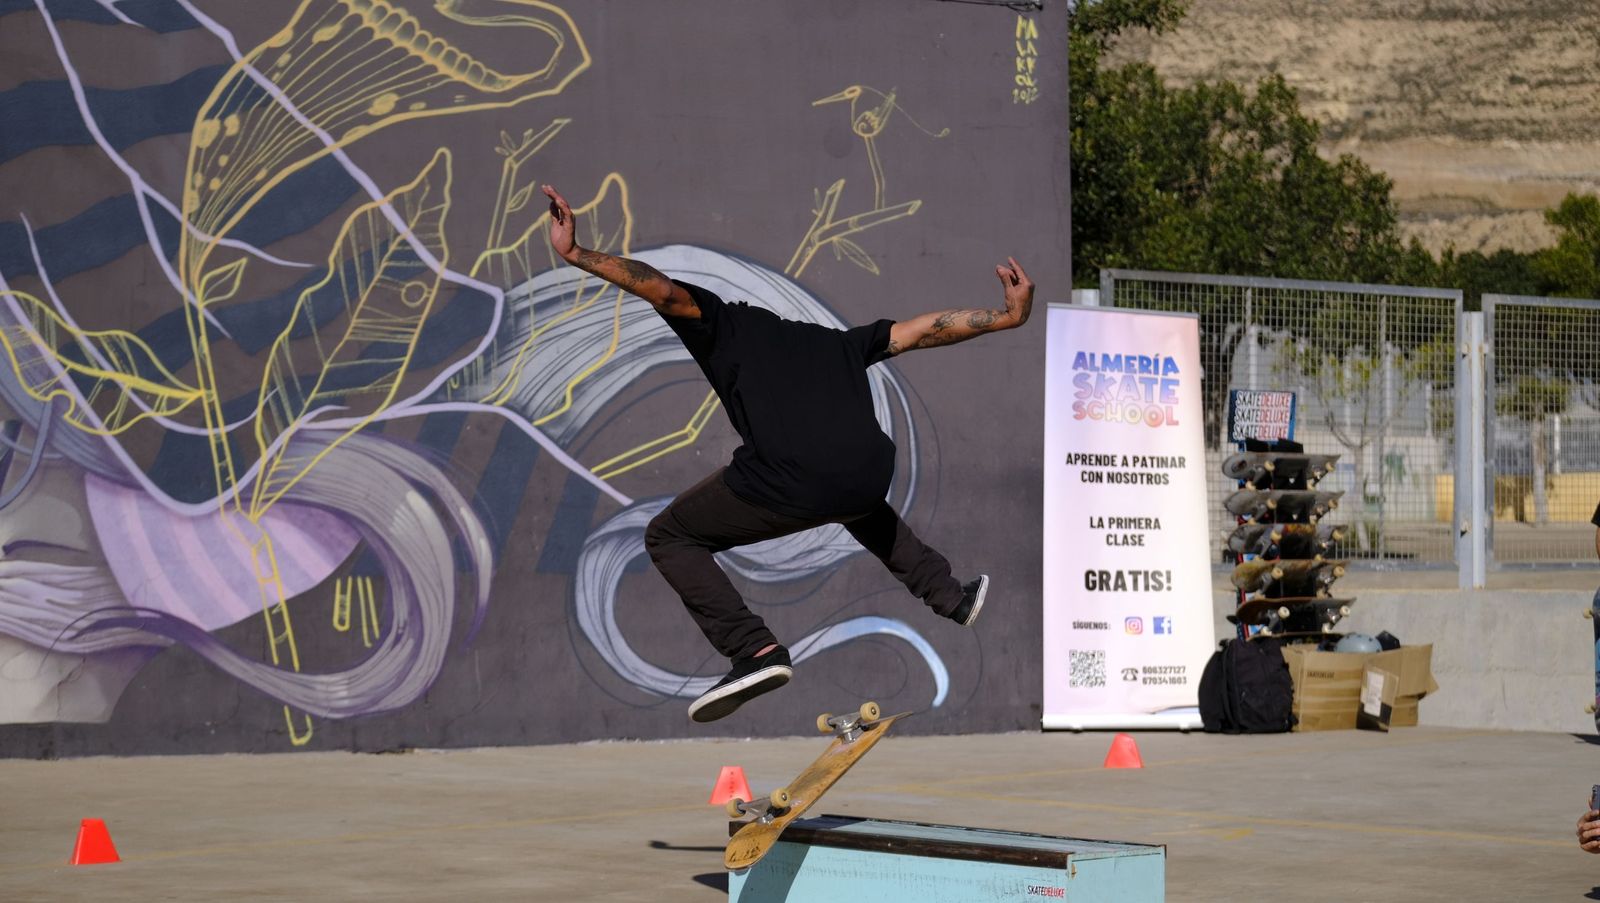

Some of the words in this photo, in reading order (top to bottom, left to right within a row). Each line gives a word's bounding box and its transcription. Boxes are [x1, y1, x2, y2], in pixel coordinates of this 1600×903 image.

[1072, 351, 1180, 376] ALMERÍA
[1072, 372, 1180, 405] SKATE
[1072, 400, 1179, 428] SCHOOL
[1065, 453, 1118, 467] APRENDE
[1121, 455, 1129, 467] A
[1133, 456, 1186, 469] PATINAR
[1081, 471, 1103, 483] CON
[1107, 472, 1170, 485] NOSOTROS
[1089, 516, 1105, 529] LA
[1108, 517, 1161, 530] PRIMERA
[1106, 534, 1145, 546] CLASE
[1084, 570, 1172, 592] GRATIS!
[1027, 885, 1065, 898] SKATEDELUXE
